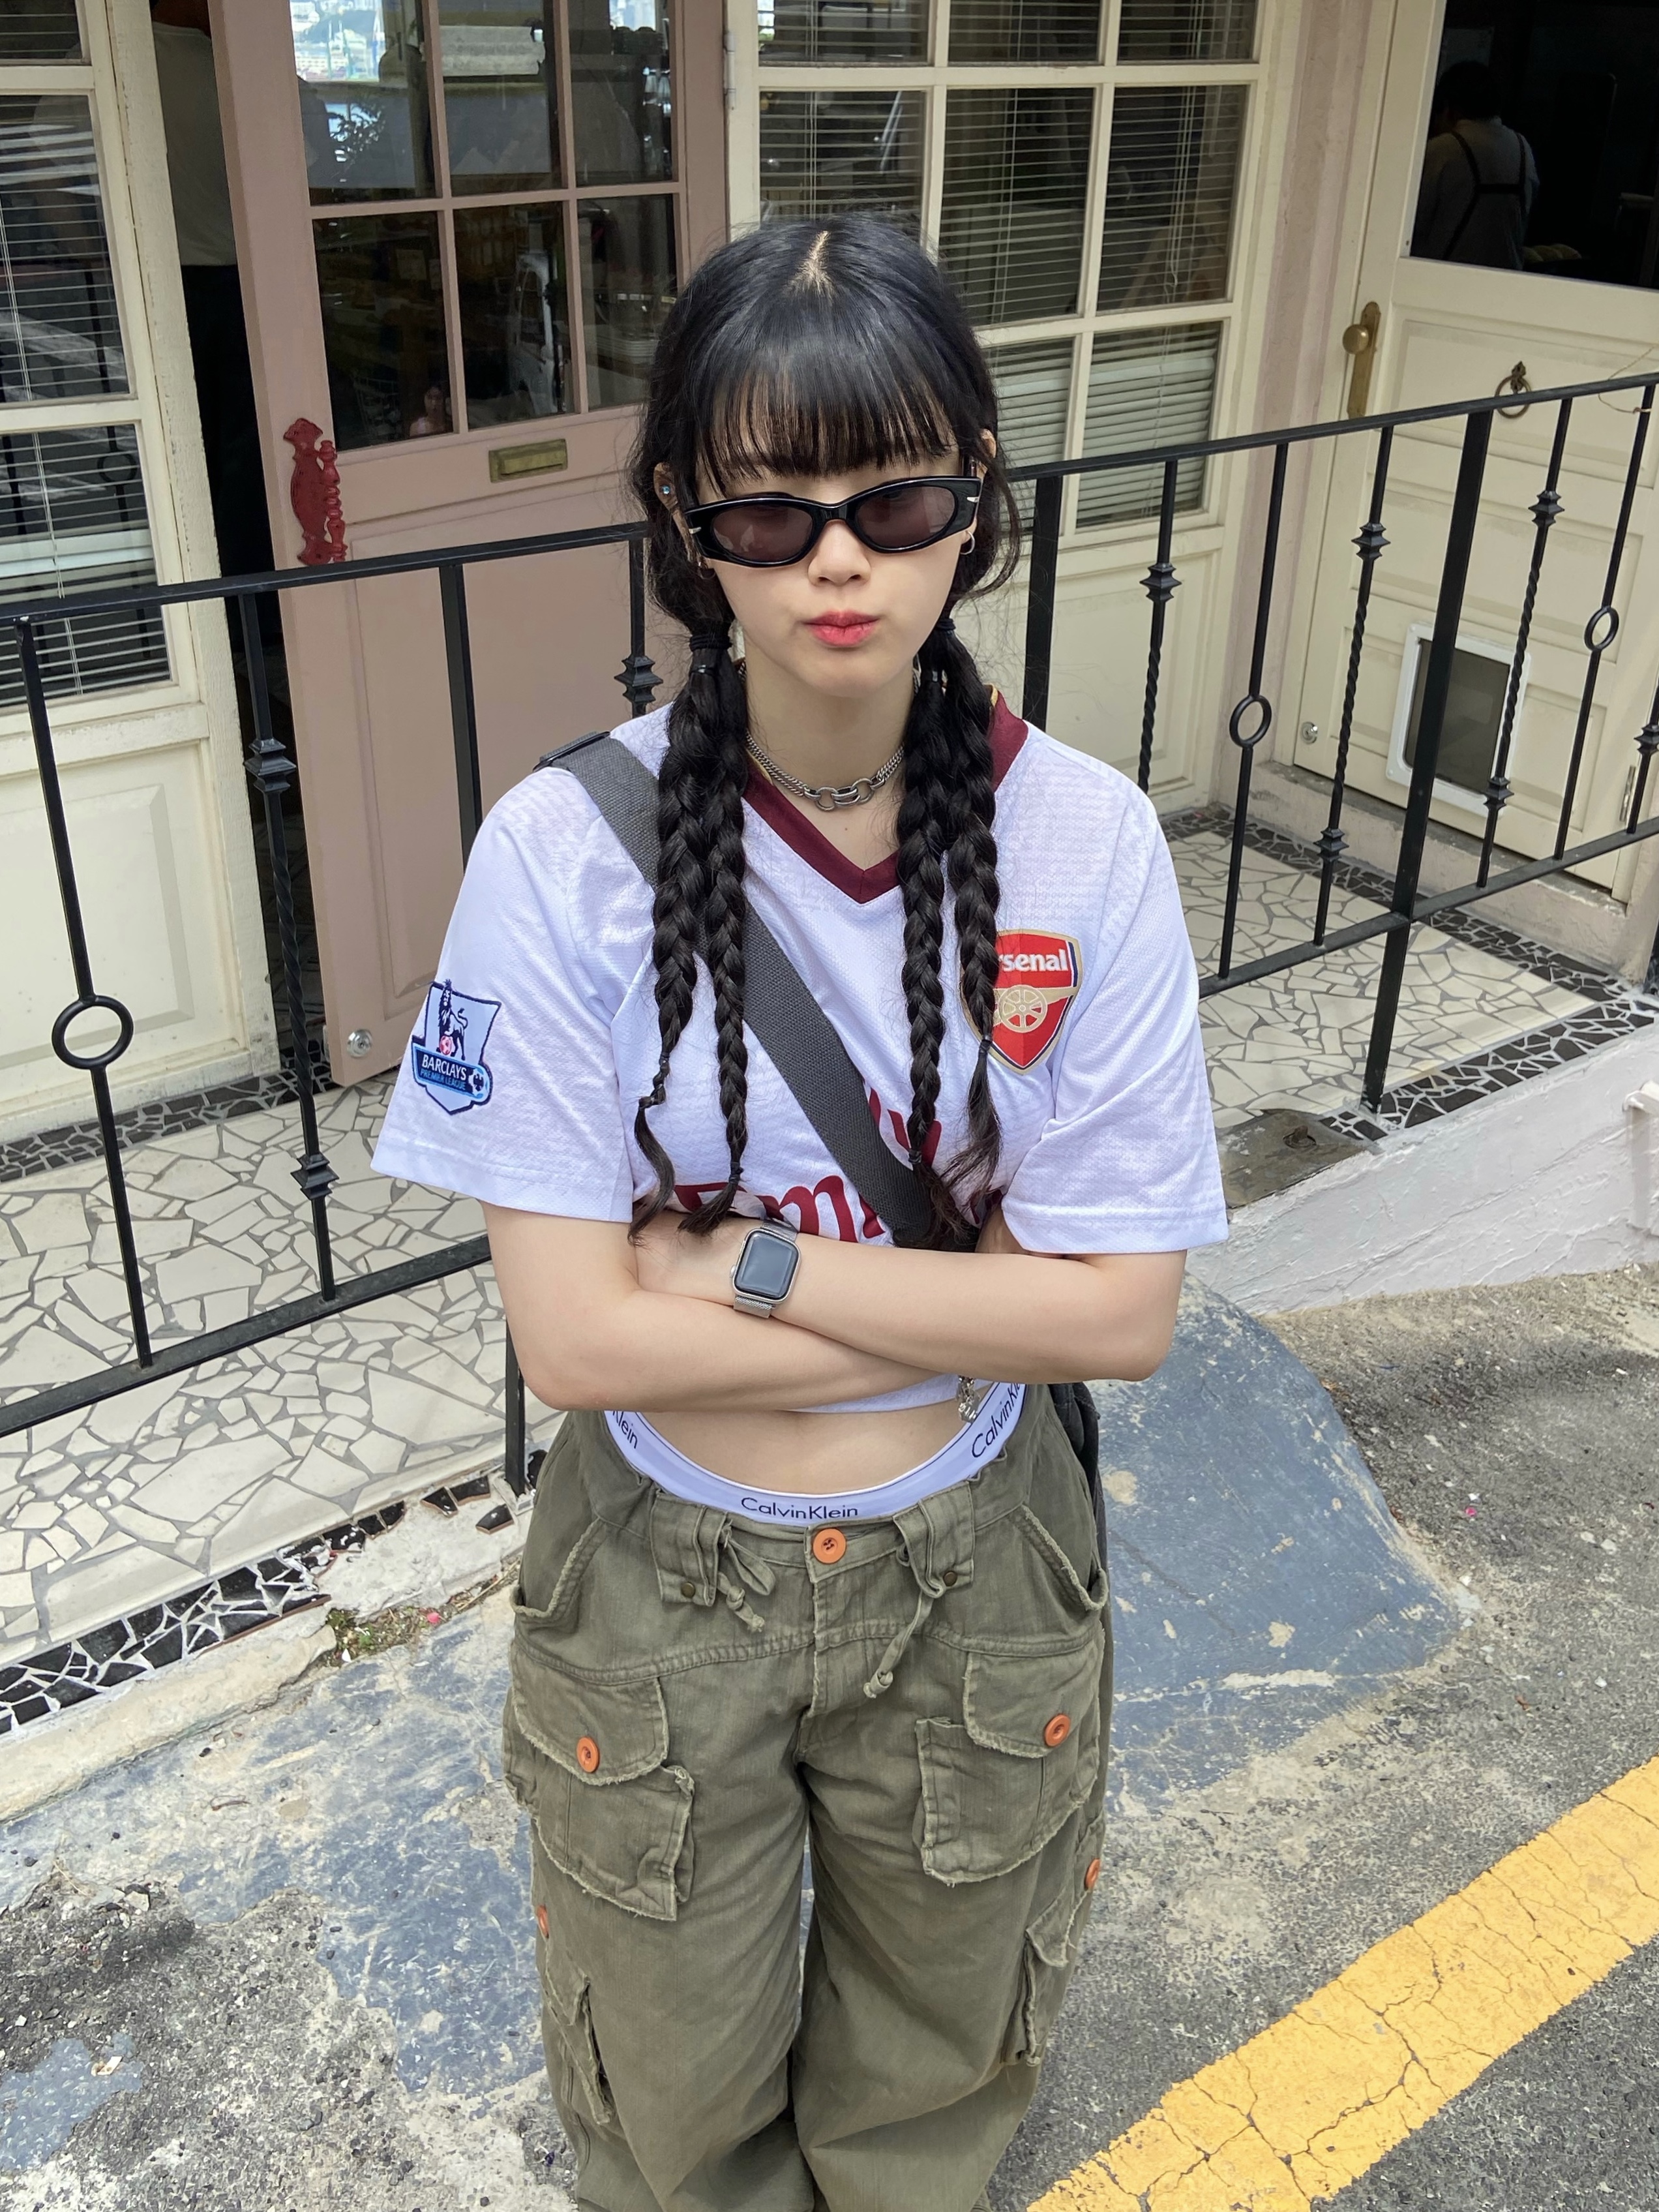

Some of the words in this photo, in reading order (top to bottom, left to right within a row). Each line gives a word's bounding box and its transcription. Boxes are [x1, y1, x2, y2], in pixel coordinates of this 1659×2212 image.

[998, 948, 1069, 972] senal
[421, 1053, 467, 1081] BARCLAYS
[420, 1068, 445, 1083] PREMIER
[445, 1076, 466, 1091] LEAGUE
